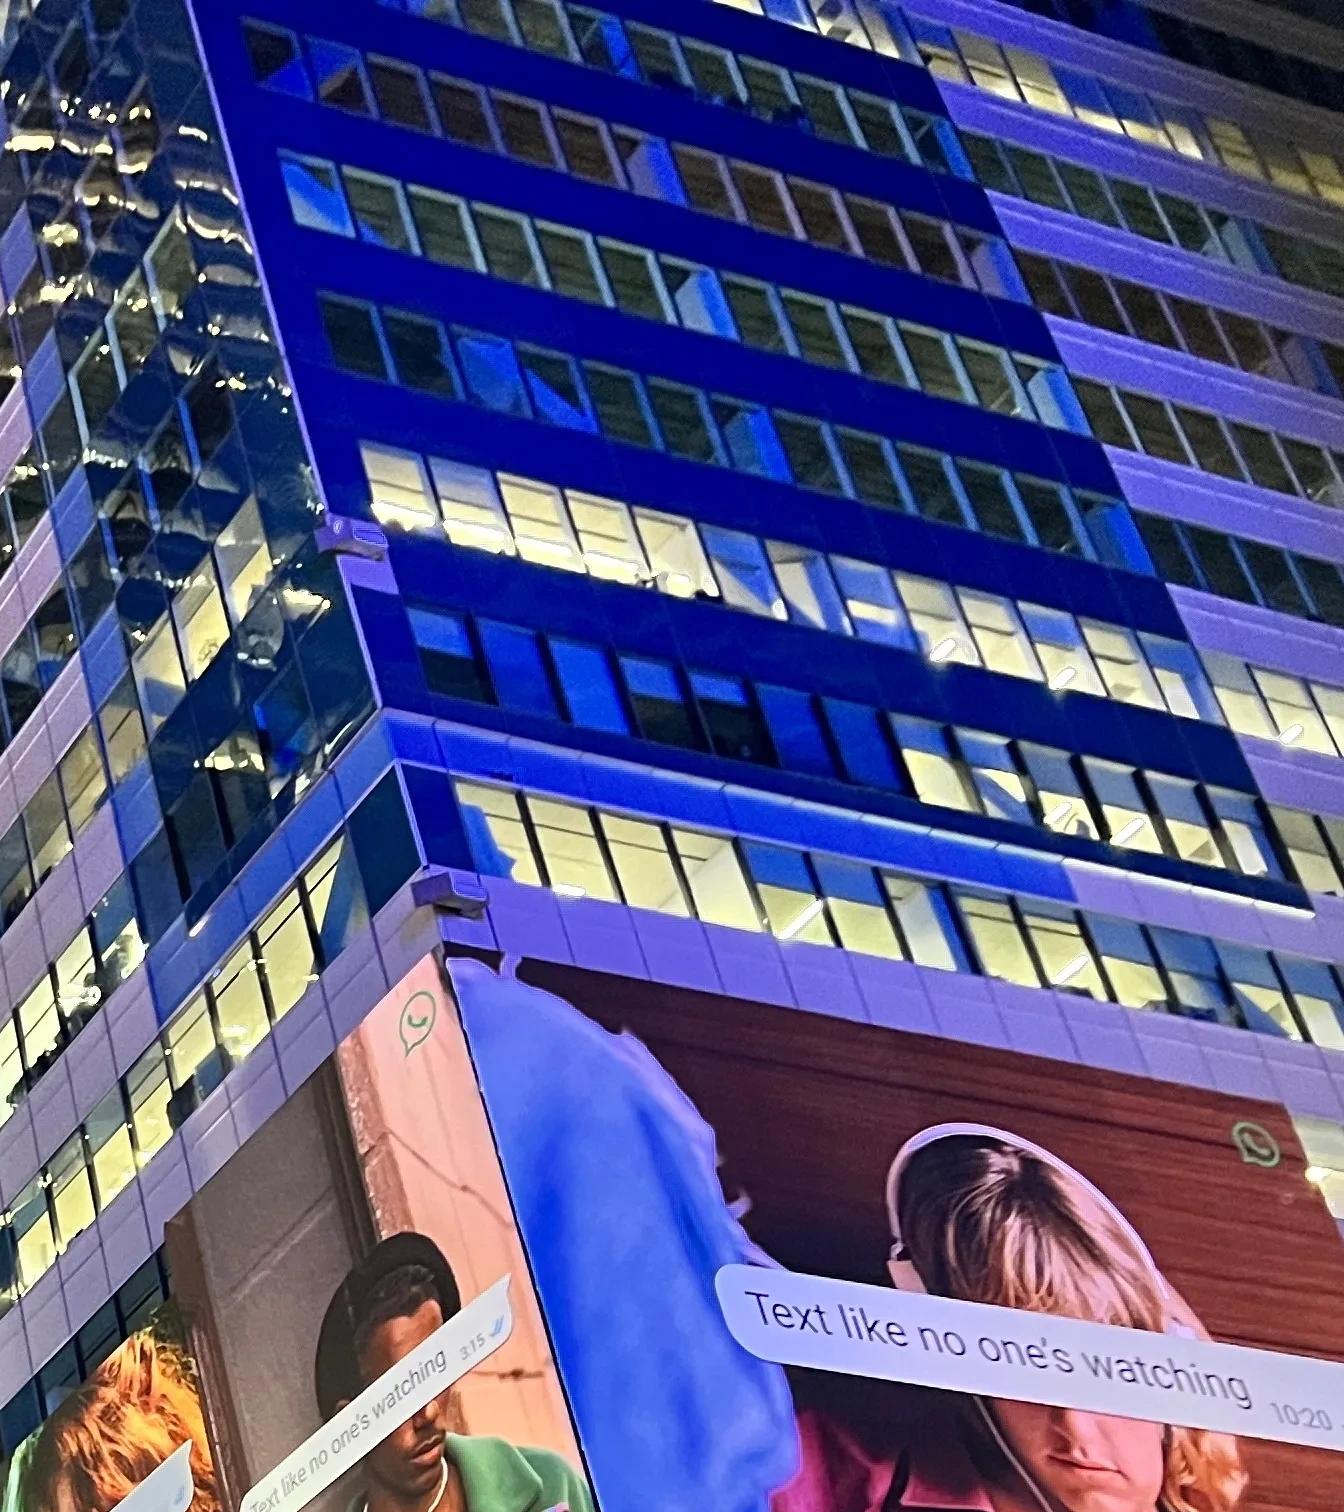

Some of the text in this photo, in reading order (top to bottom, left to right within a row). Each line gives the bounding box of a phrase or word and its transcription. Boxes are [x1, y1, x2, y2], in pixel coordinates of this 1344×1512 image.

[280, 1464, 308, 1498] like
[310, 1448, 329, 1475] no
[330, 1411, 370, 1455] one's
[371, 1350, 447, 1419] watching
[458, 1333, 486, 1361] 3:15
[745, 1290, 834, 1337] Text
[840, 1306, 909, 1348] like
[919, 1325, 967, 1357] no
[979, 1337, 1075, 1374] one's
[1081, 1351, 1254, 1411] watching
